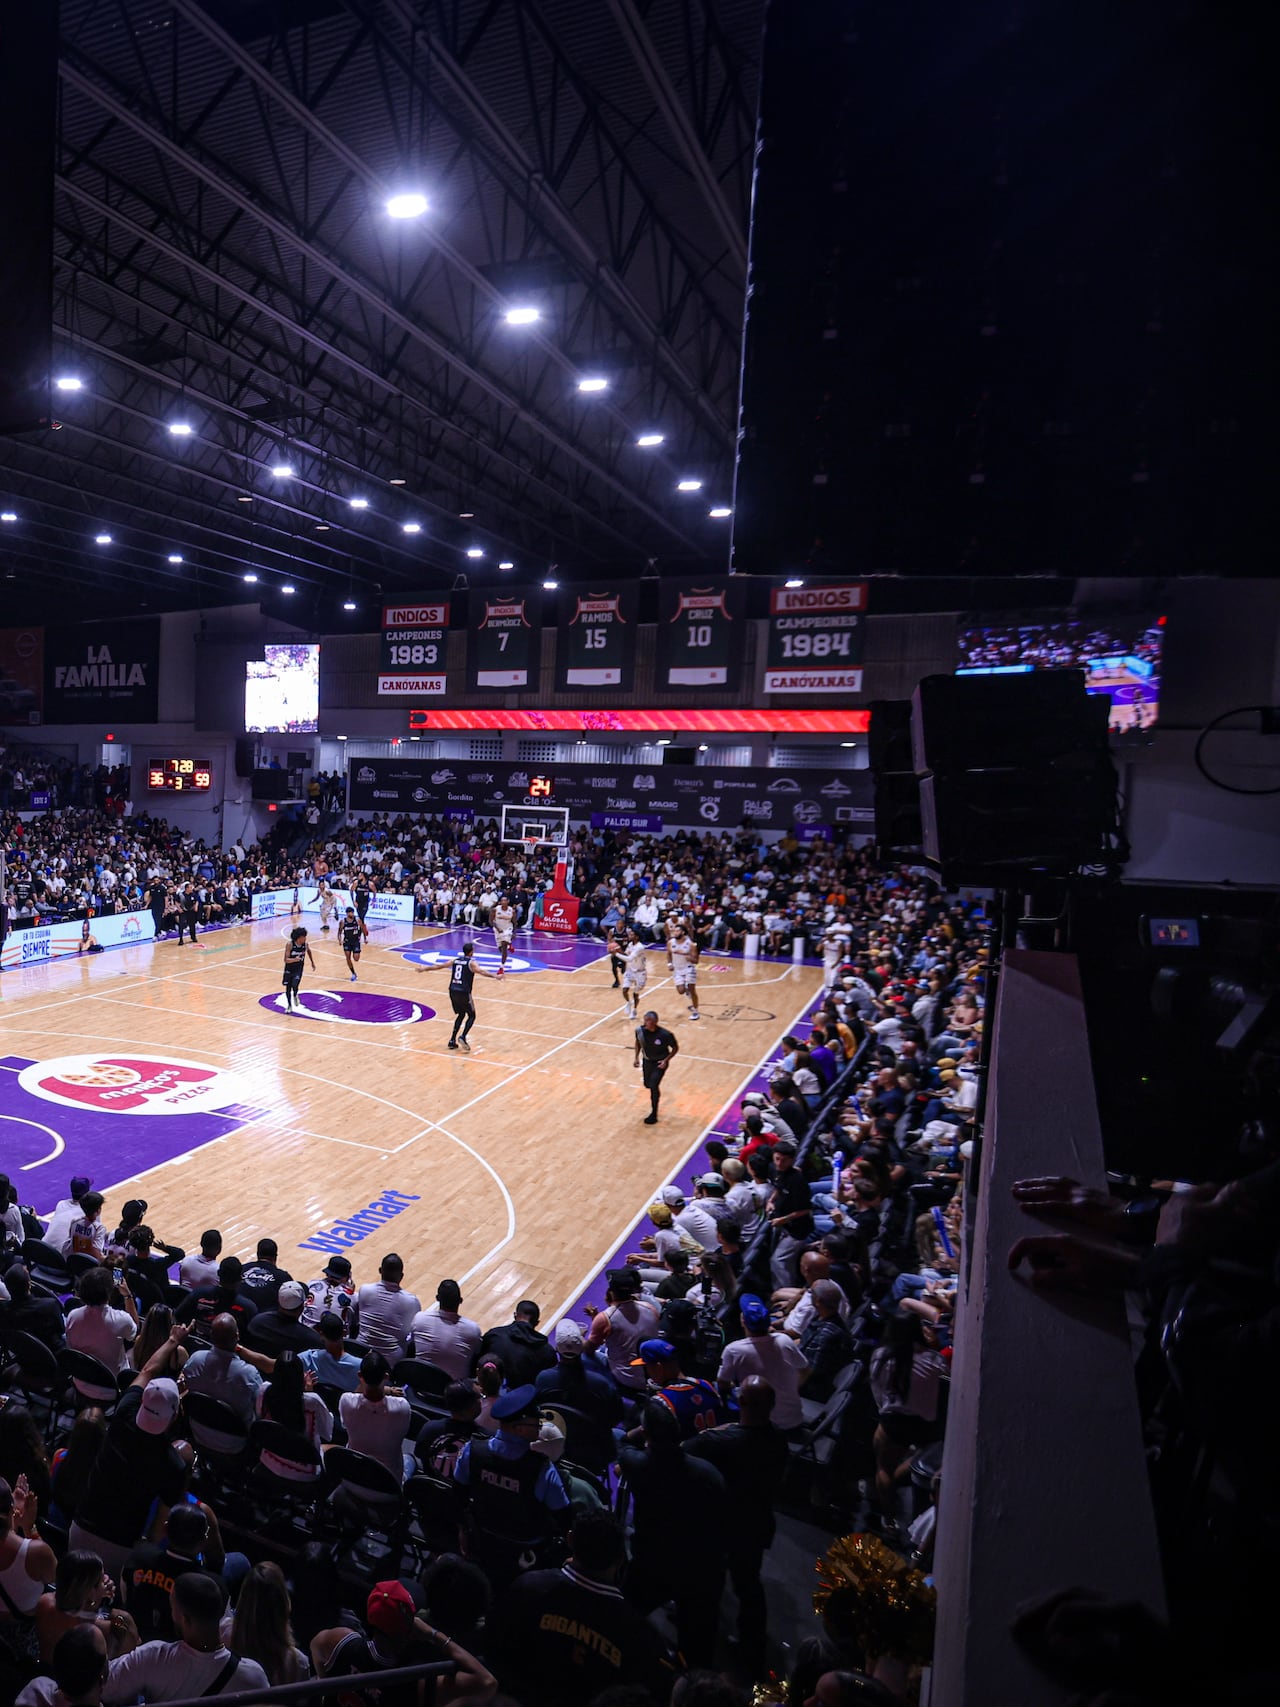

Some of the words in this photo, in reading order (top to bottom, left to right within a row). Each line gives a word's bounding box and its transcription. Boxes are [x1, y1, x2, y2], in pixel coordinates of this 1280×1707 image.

[785, 590, 851, 608] INDIOS
[392, 609, 438, 623] INDIOS
[581, 612, 613, 624] RAMOS
[687, 609, 714, 621] CRUZ
[776, 615, 859, 630] CAMPEONES
[385, 630, 443, 642] CAMPEONES
[498, 632, 510, 652] 7
[584, 628, 608, 649] 15
[687, 626, 712, 648] 10
[781, 632, 852, 658] 1984
[87, 645, 113, 664] LA
[389, 644, 439, 666] 1983
[382, 679, 442, 691] CANÓVANAS
[771, 673, 856, 688] CANÓVANAS
[150, 771, 164, 786] 36
[529, 777, 552, 797] 24
[604, 817, 631, 827] PALCO
[539, 921, 572, 930] MATTRESS
[543, 916, 569, 924] GLOBAL
[22, 939, 51, 961] SIEMPRE
[454, 964, 463, 980] 8
[98, 1069, 181, 1100] MARCO'S
[165, 1085, 214, 1104] PIZZA
[297, 1189, 422, 1255] Walmart
[538, 1612, 623, 1669] GIGANTES
